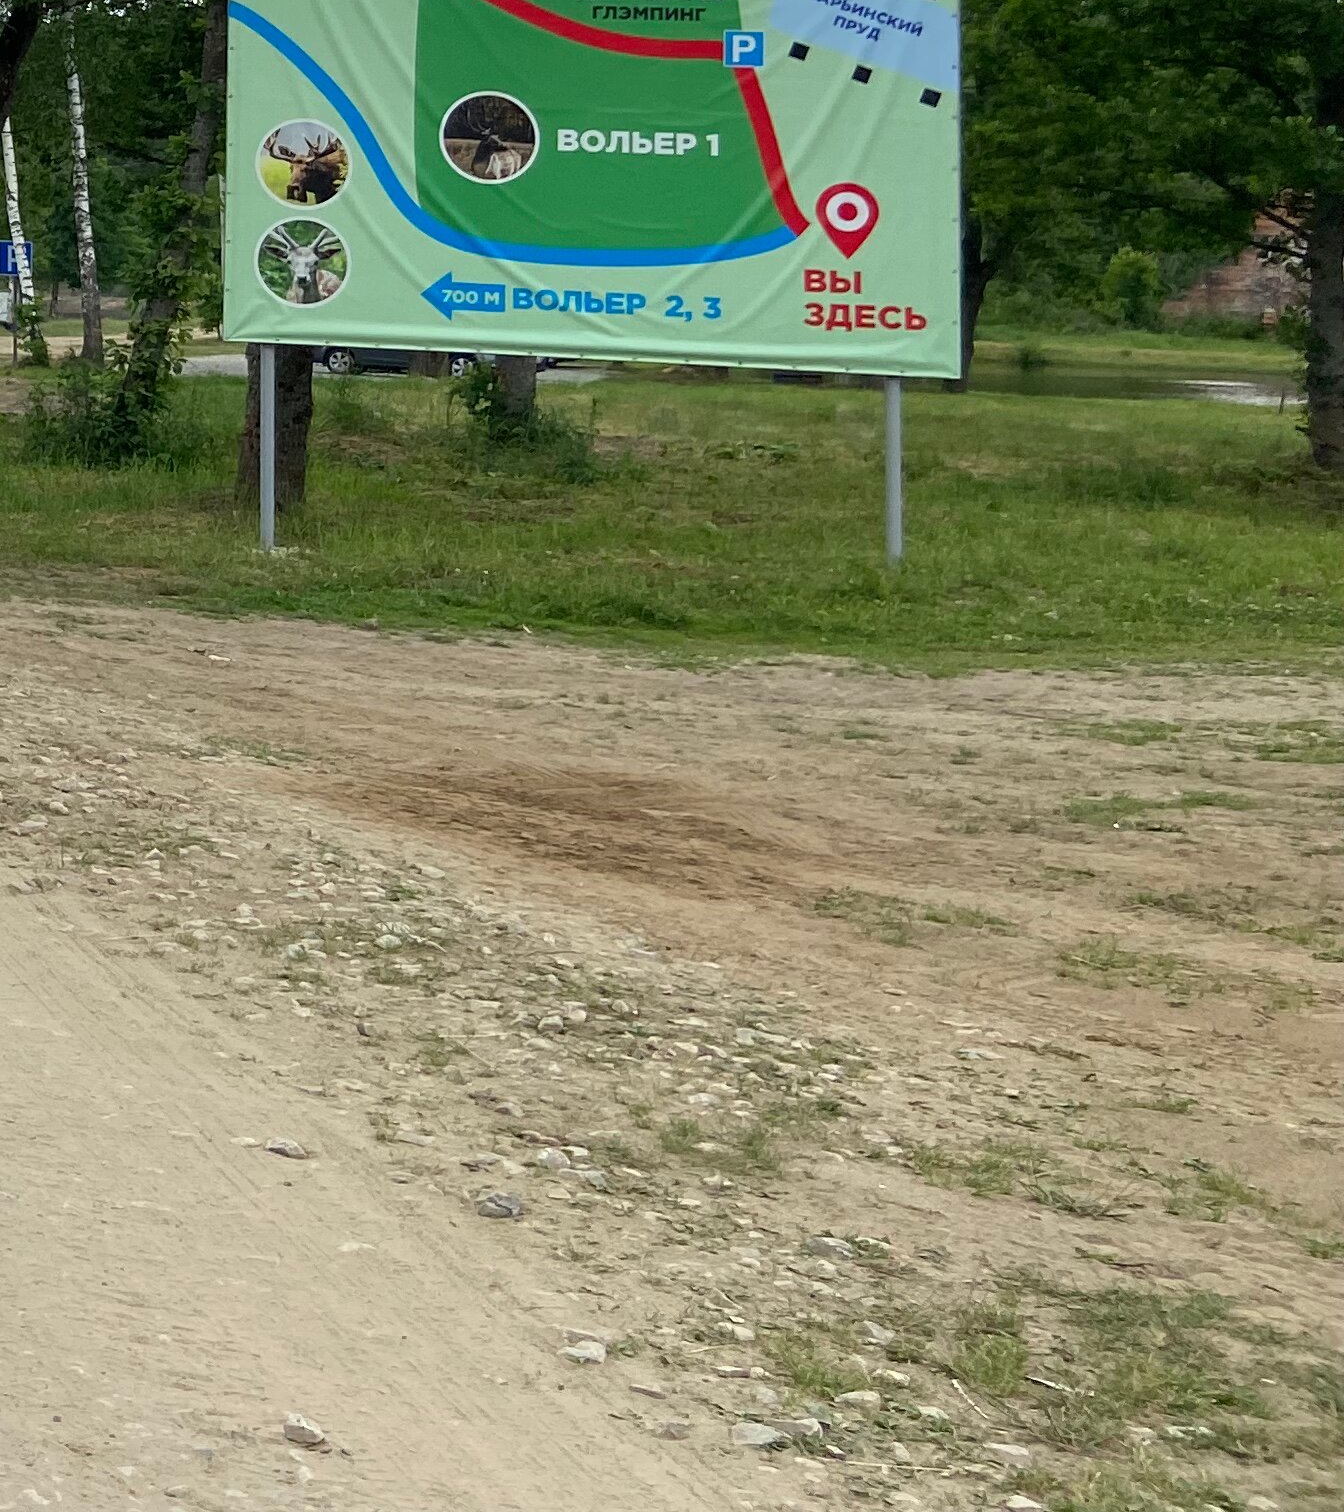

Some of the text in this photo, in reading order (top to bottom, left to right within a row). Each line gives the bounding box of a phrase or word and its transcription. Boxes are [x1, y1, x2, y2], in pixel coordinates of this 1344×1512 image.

[591, 5, 707, 22] ГЛЭМПИНГ
[832, 14, 882, 42] ПРУД
[731, 34, 757, 63] P
[556, 128, 720, 157] ВОЛЬЕР 1
[803, 268, 863, 295] ВЫ
[441, 289, 479, 305] 700
[512, 287, 647, 316] ВОЛЬЕР
[664, 295, 693, 322] 2,
[702, 296, 722, 319] 3
[803, 302, 929, 332] ЗДЕСЬ
